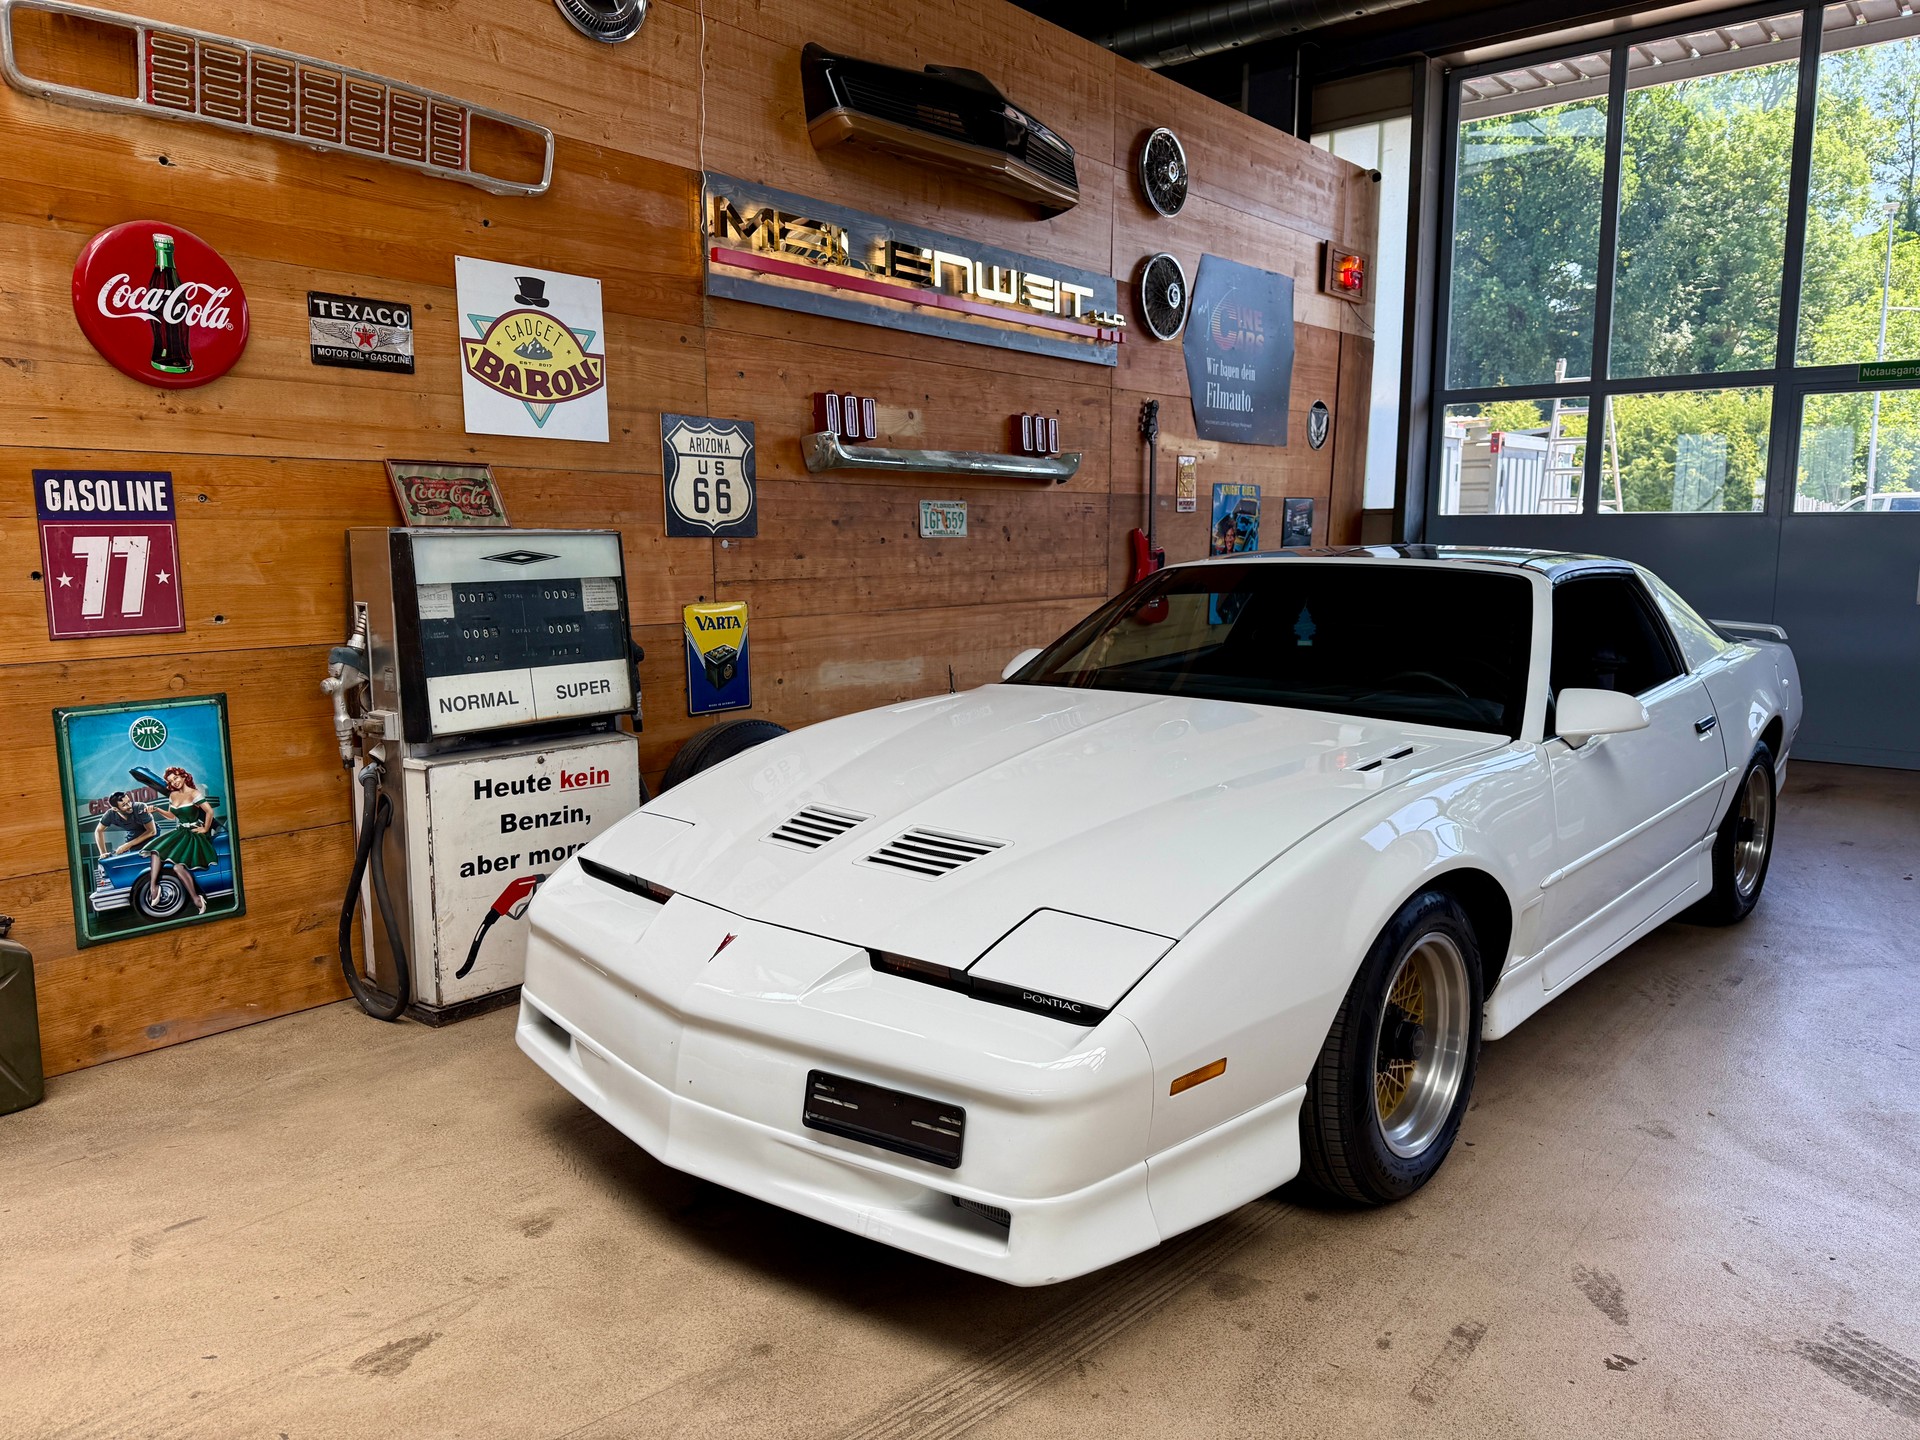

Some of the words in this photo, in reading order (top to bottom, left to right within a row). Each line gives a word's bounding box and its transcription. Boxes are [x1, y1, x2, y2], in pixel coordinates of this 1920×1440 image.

[97, 273, 234, 330] Coca-Cola
[313, 299, 408, 326] TEXACO
[504, 318, 563, 346] GADGET
[317, 347, 349, 358] MOTOR
[350, 350, 365, 360] OIL
[370, 352, 411, 365] GASOLINE
[472, 346, 600, 398] BARON
[1206, 356, 1219, 376] Wir
[1240, 363, 1256, 382] dein
[1862, 366, 1920, 377] Notausgang
[1205, 381, 1254, 413] Filmauto.
[689, 437, 731, 454] ARIZONA
[44, 479, 168, 512] GASOLINE
[410, 483, 488, 505] Coca-Cola
[693, 477, 732, 514] 66
[945, 511, 965, 529] 559
[694, 615, 742, 631] VARTA
[556, 679, 611, 699] SUPER
[439, 690, 519, 714] NORMAL
[136, 726, 160, 736] NTK
[474, 773, 552, 800] Heute
[560, 766, 611, 790] kein
[500, 805, 591, 834] Benzin,
[460, 853, 520, 878] aber
[1023, 991, 1082, 1013] PONTIAC
